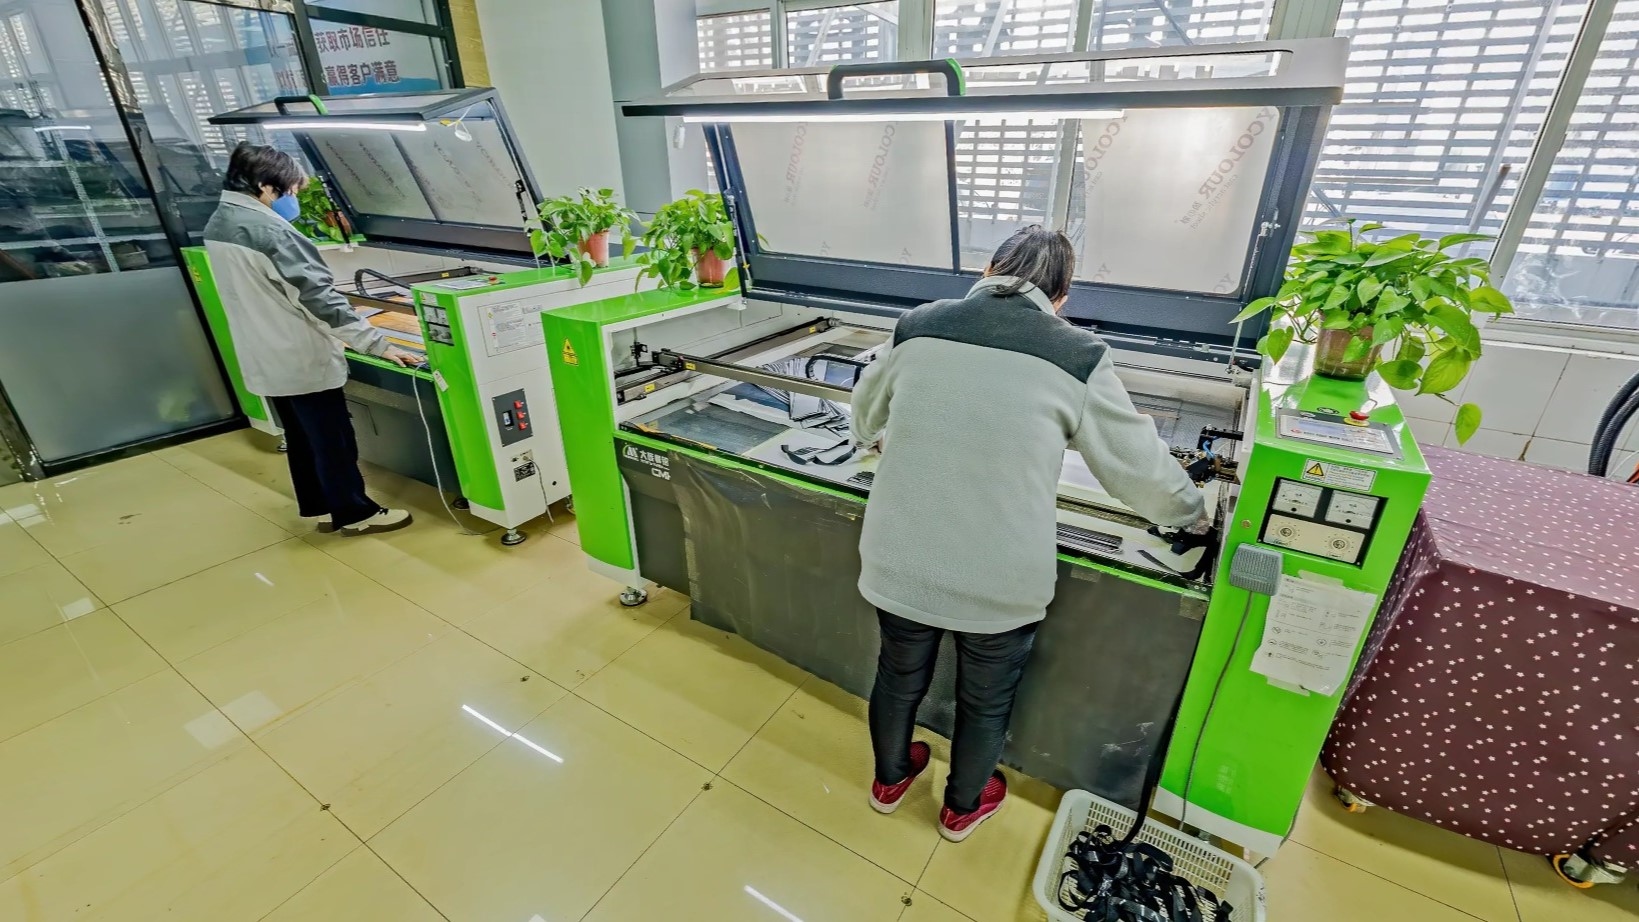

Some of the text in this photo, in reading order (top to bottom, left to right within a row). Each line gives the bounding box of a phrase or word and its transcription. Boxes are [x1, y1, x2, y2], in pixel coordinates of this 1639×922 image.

[315, 27, 390, 53] 获取市场信任
[324, 60, 400, 86] 赢得客户满意
